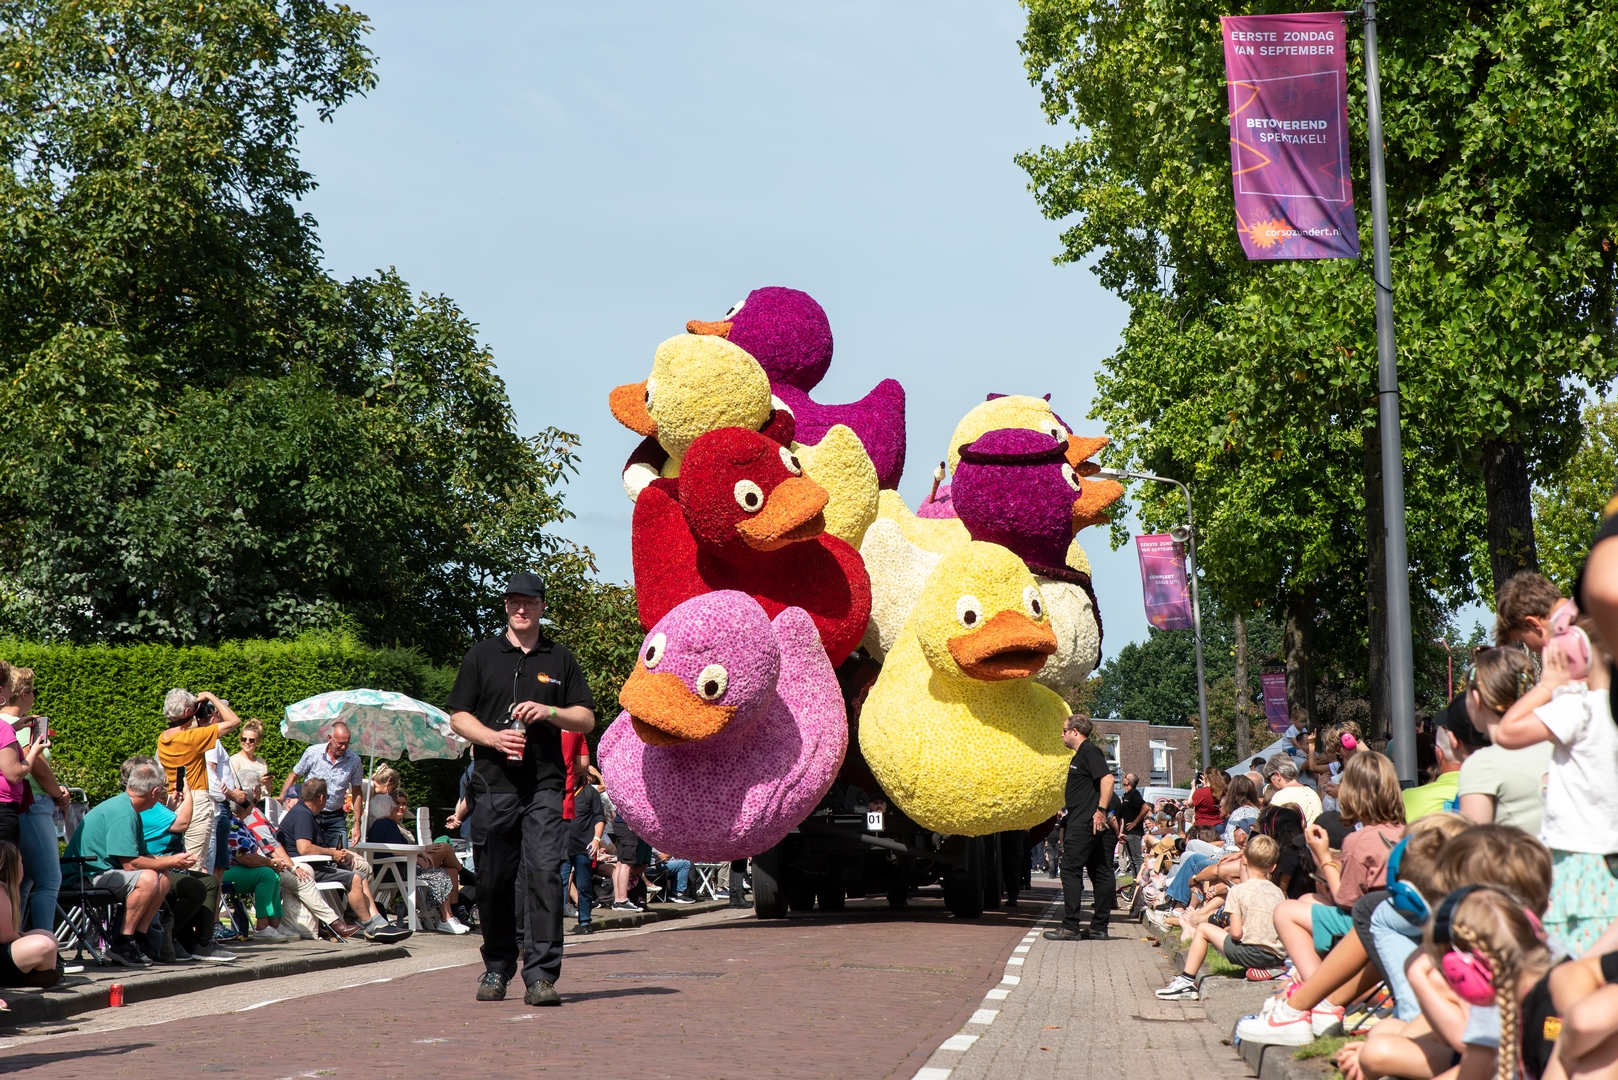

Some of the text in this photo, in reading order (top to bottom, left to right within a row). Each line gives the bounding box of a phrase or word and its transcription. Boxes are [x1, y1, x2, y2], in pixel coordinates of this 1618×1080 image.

[1231, 31, 1334, 41] EERSTE ZONDAG
[1233, 45, 1334, 55] VAN SEPTEMBER
[1246, 118, 1328, 130] BETOVEREND
[1260, 132, 1326, 144] SPEKTAKEL!
[1265, 228, 1342, 236] corsozundert.nl
[869, 815, 880, 824] 01
